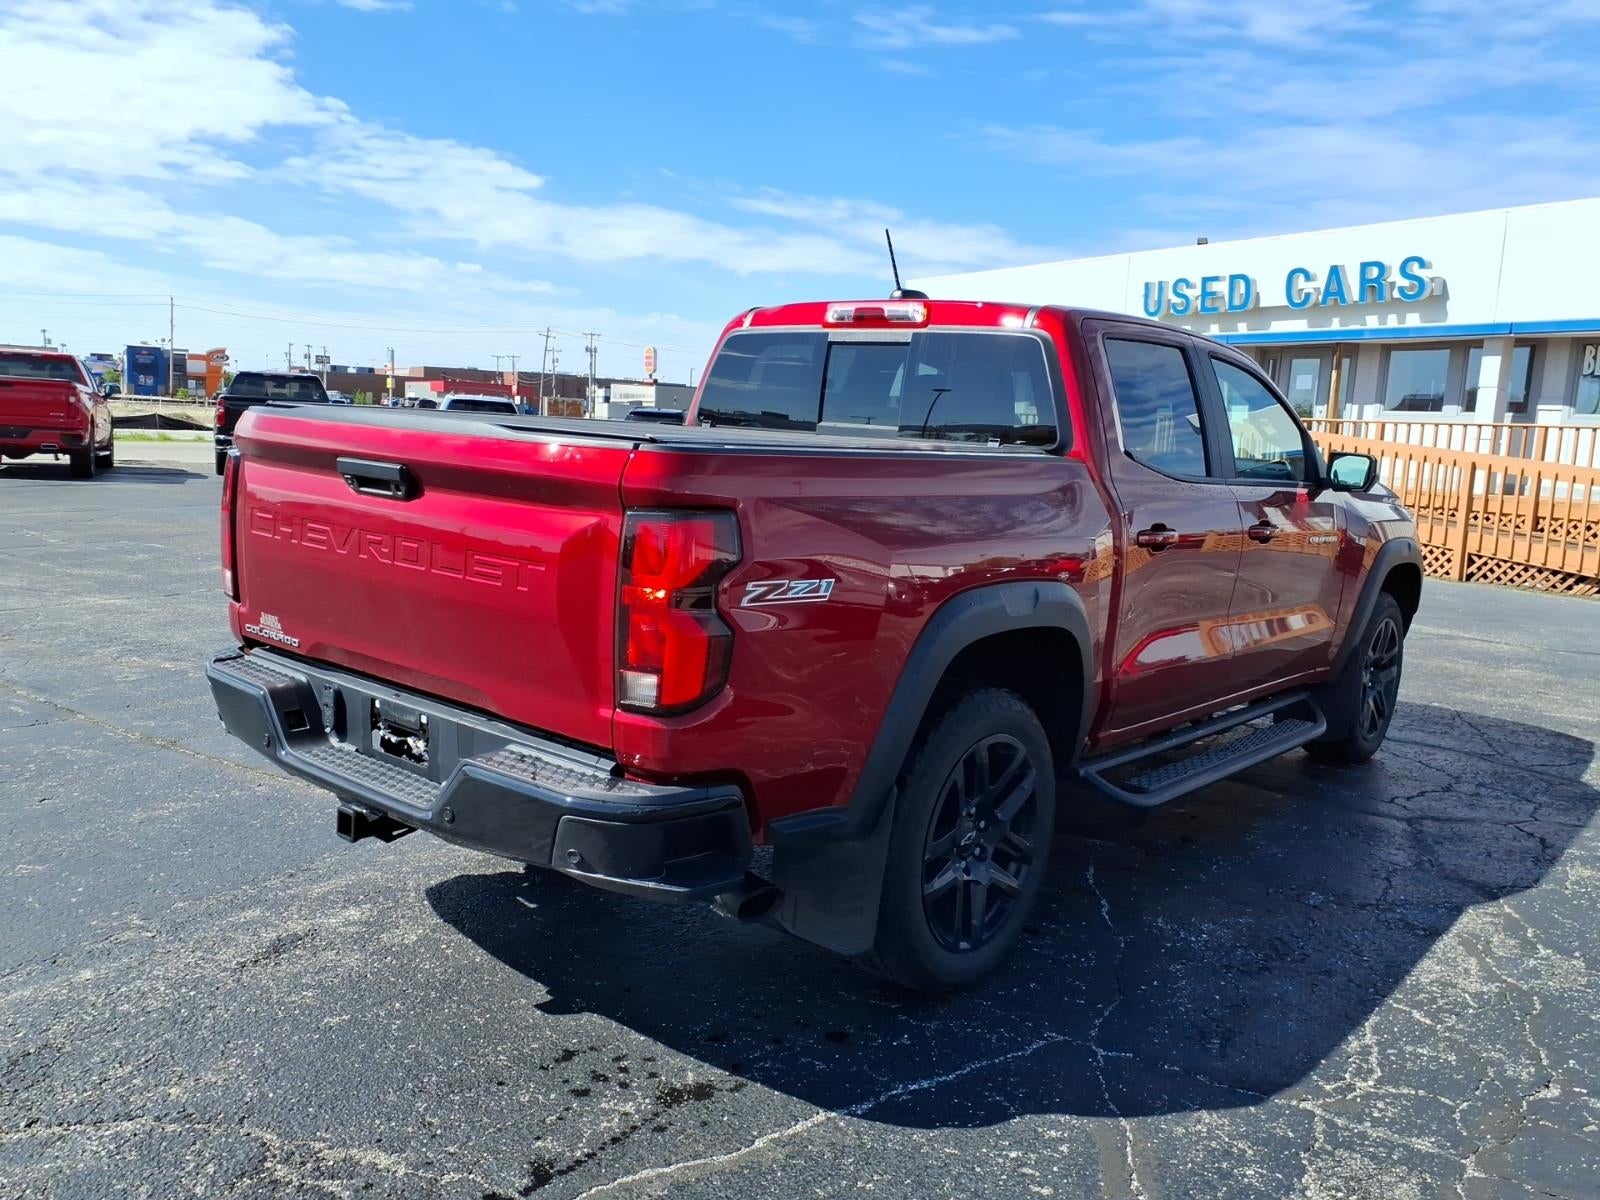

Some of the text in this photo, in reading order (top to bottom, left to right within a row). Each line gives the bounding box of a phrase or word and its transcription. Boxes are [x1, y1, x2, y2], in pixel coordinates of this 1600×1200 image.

[1143, 255, 1432, 318] USED CARS
[250, 506, 546, 592] CHEVROLET
[740, 578, 835, 607] Z71
[244, 623, 299, 647] COLORADO
